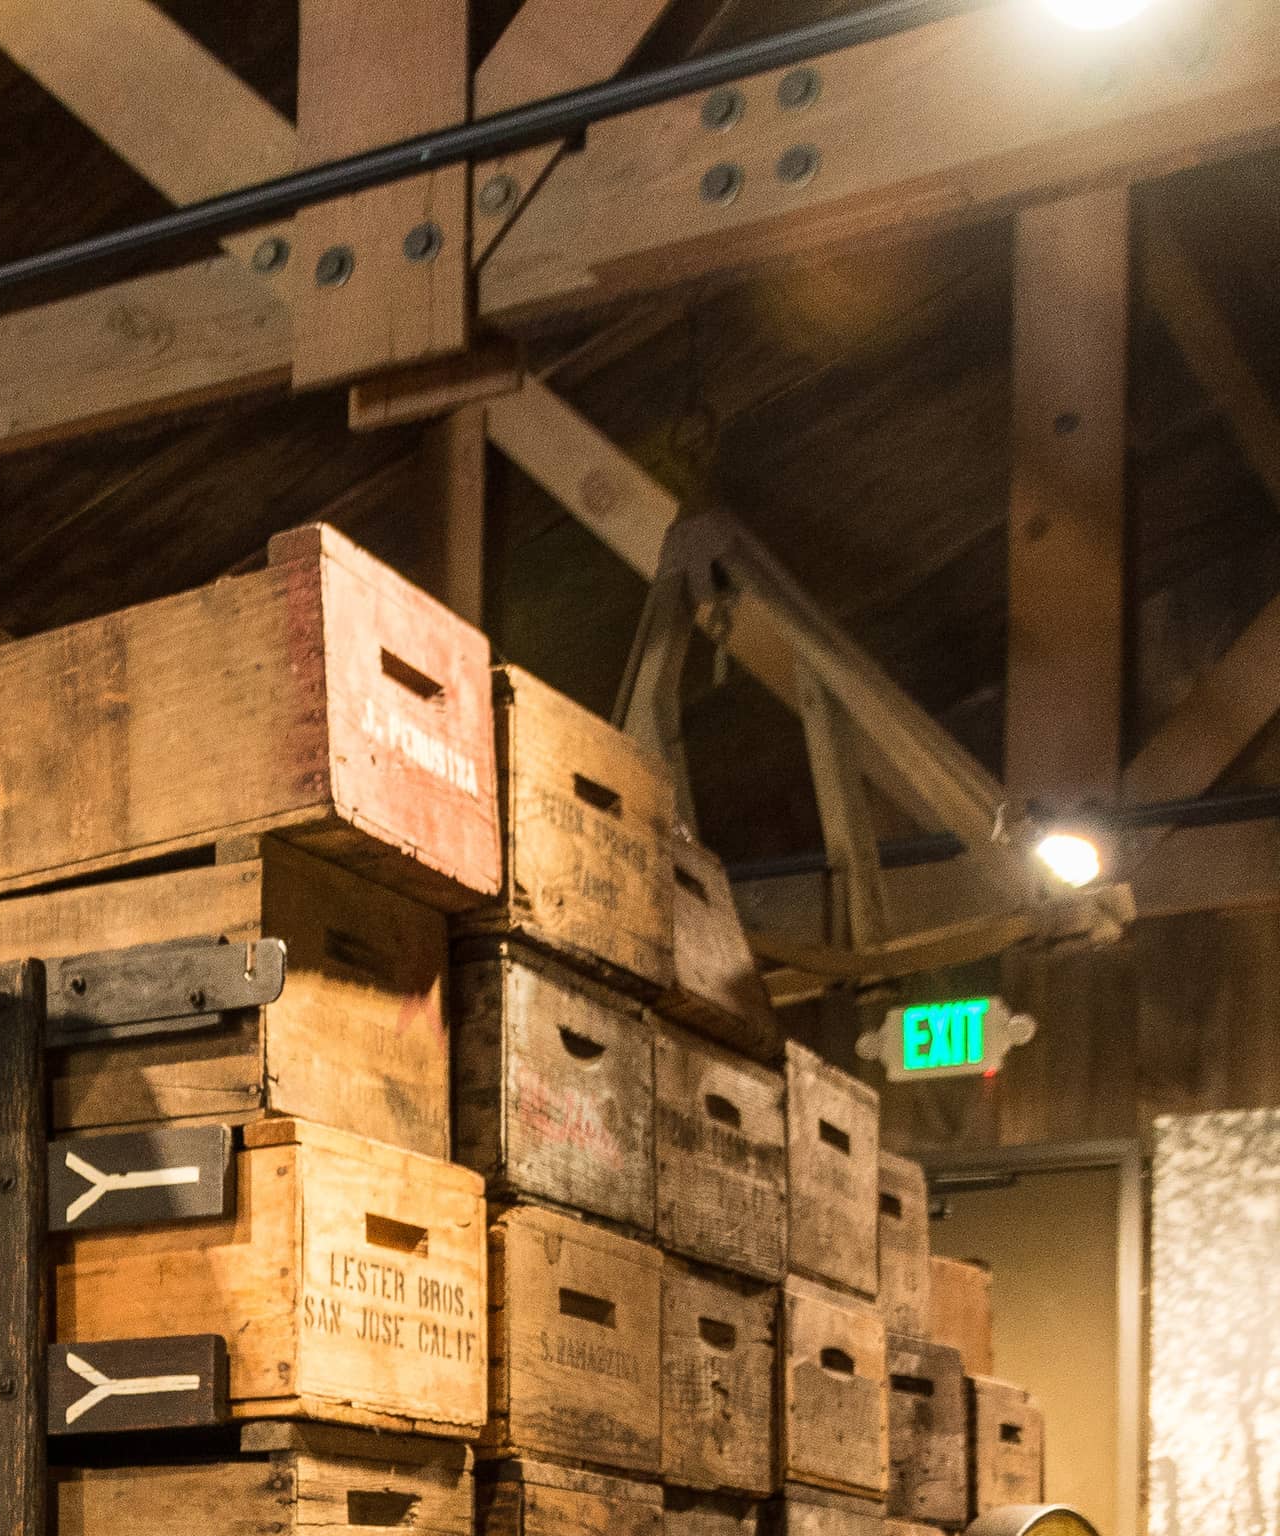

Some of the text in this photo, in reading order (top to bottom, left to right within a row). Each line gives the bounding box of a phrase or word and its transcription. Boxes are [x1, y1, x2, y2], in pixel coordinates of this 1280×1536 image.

[903, 998, 990, 1071] EXIT
[330, 1252, 474, 1320] LESTER BROS.
[304, 1295, 341, 1334] SAN
[356, 1307, 405, 1348] JOSE
